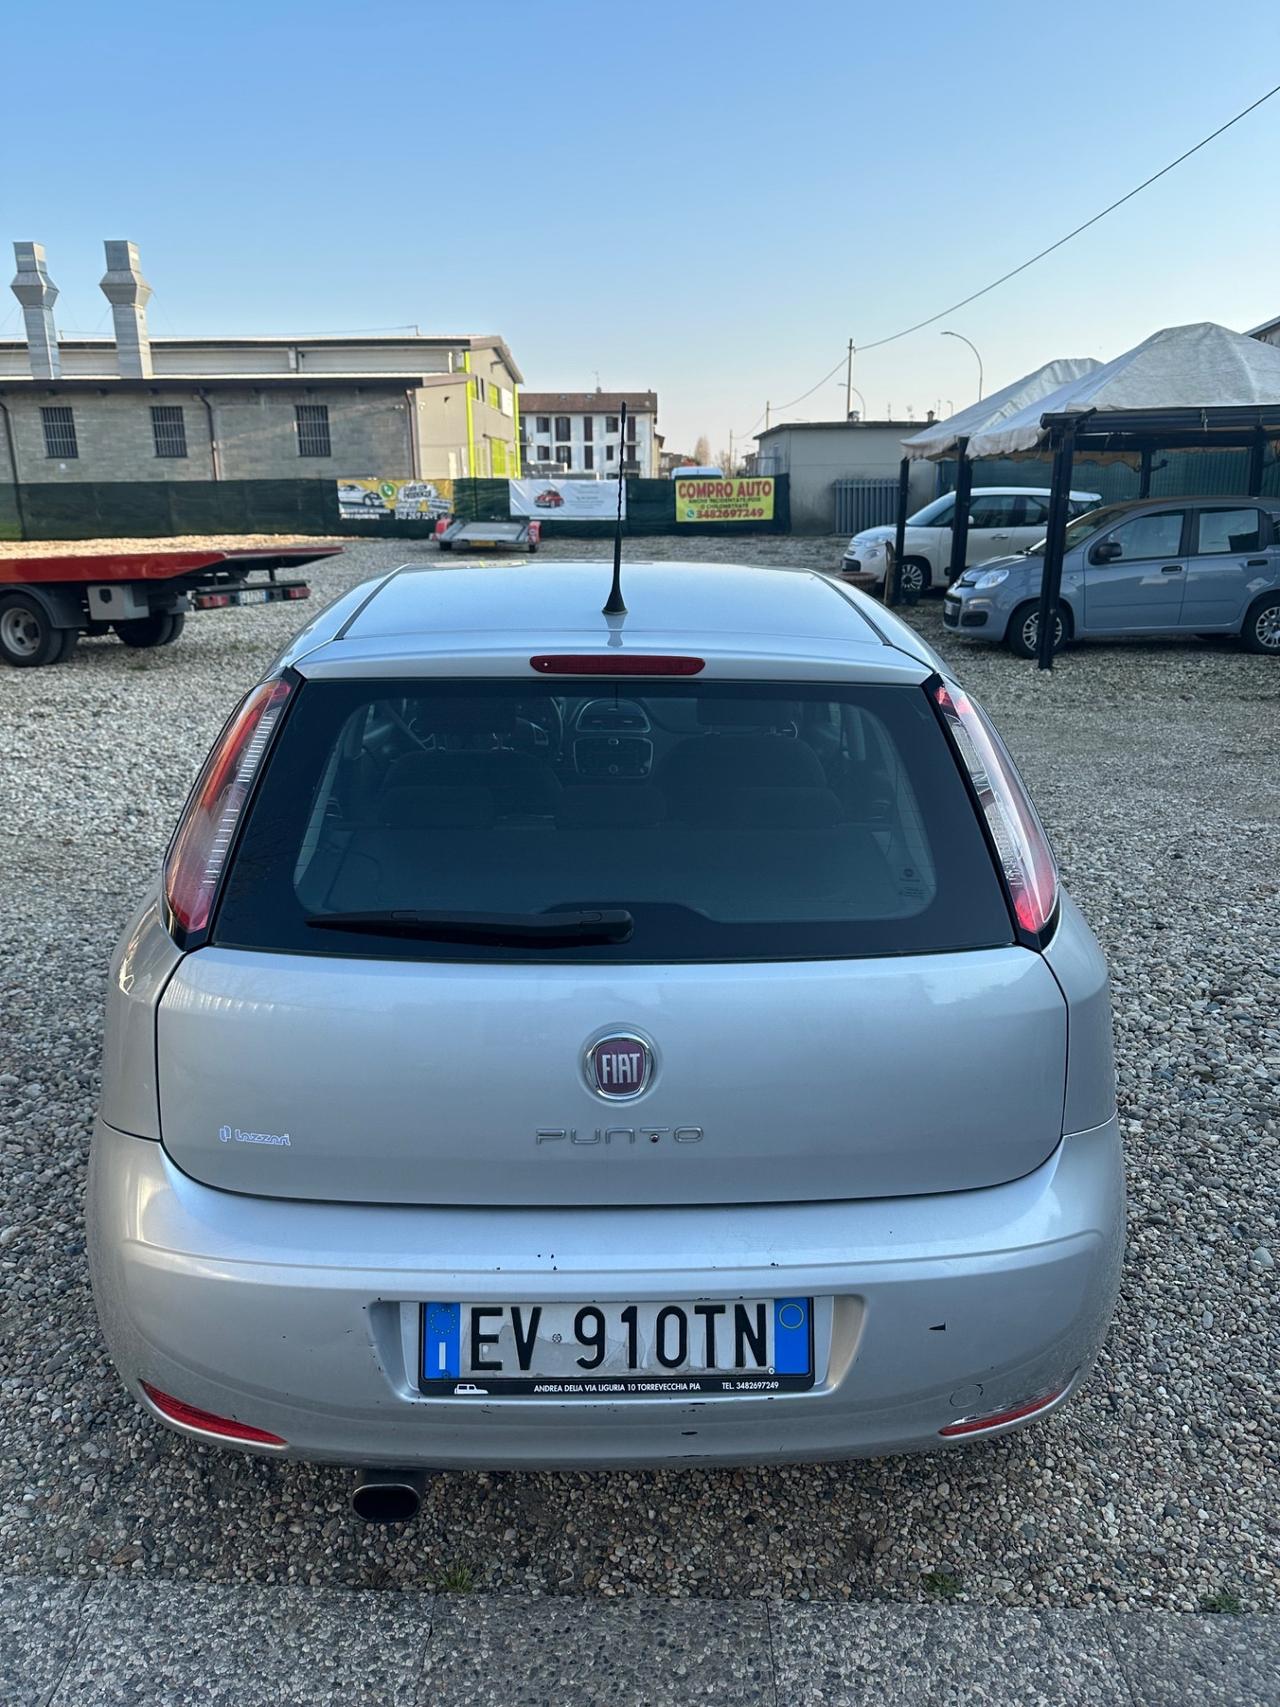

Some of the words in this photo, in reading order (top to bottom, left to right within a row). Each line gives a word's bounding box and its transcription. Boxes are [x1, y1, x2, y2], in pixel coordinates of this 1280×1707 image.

[679, 481, 733, 499] COMPRO
[737, 481, 772, 497] AUTO
[696, 508, 764, 518] 3482697249
[601, 1053, 640, 1084] FIAT
[536, 1126, 704, 1145] PUNTO
[470, 1306, 542, 1371] EV
[637, 1383, 688, 1391] TORREVECCHIA
[689, 1382, 701, 1390] PIA
[722, 1381, 735, 1390] TEL.
[736, 1381, 779, 1390] 3482697249
